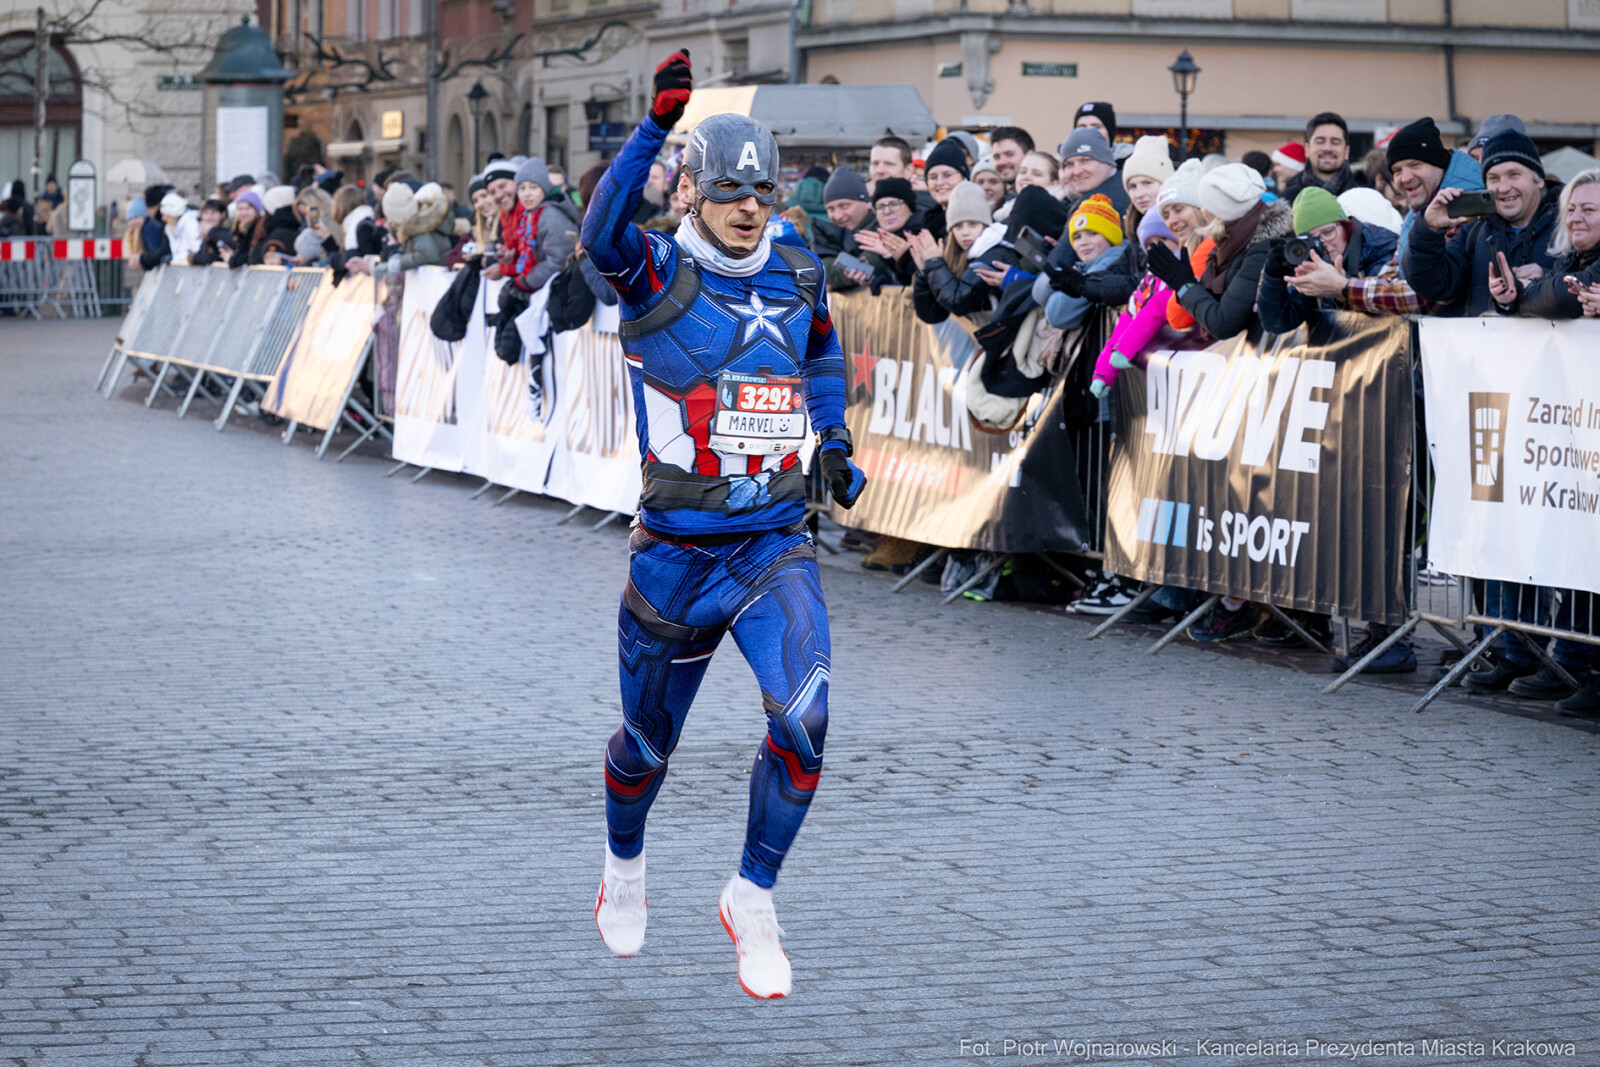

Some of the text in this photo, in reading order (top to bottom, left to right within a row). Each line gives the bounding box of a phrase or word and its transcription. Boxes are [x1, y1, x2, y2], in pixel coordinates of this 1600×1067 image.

[735, 141, 761, 171] A
[740, 385, 792, 411] 3292
[867, 357, 973, 452] BLACK
[1527, 396, 1584, 434] Zarząd
[728, 415, 775, 433] MARVEL
[883, 456, 948, 489] ENERGY
[1523, 437, 1600, 479] Sportowe
[1519, 480, 1600, 515] w Krakow
[1196, 506, 1310, 568] is SPORT
